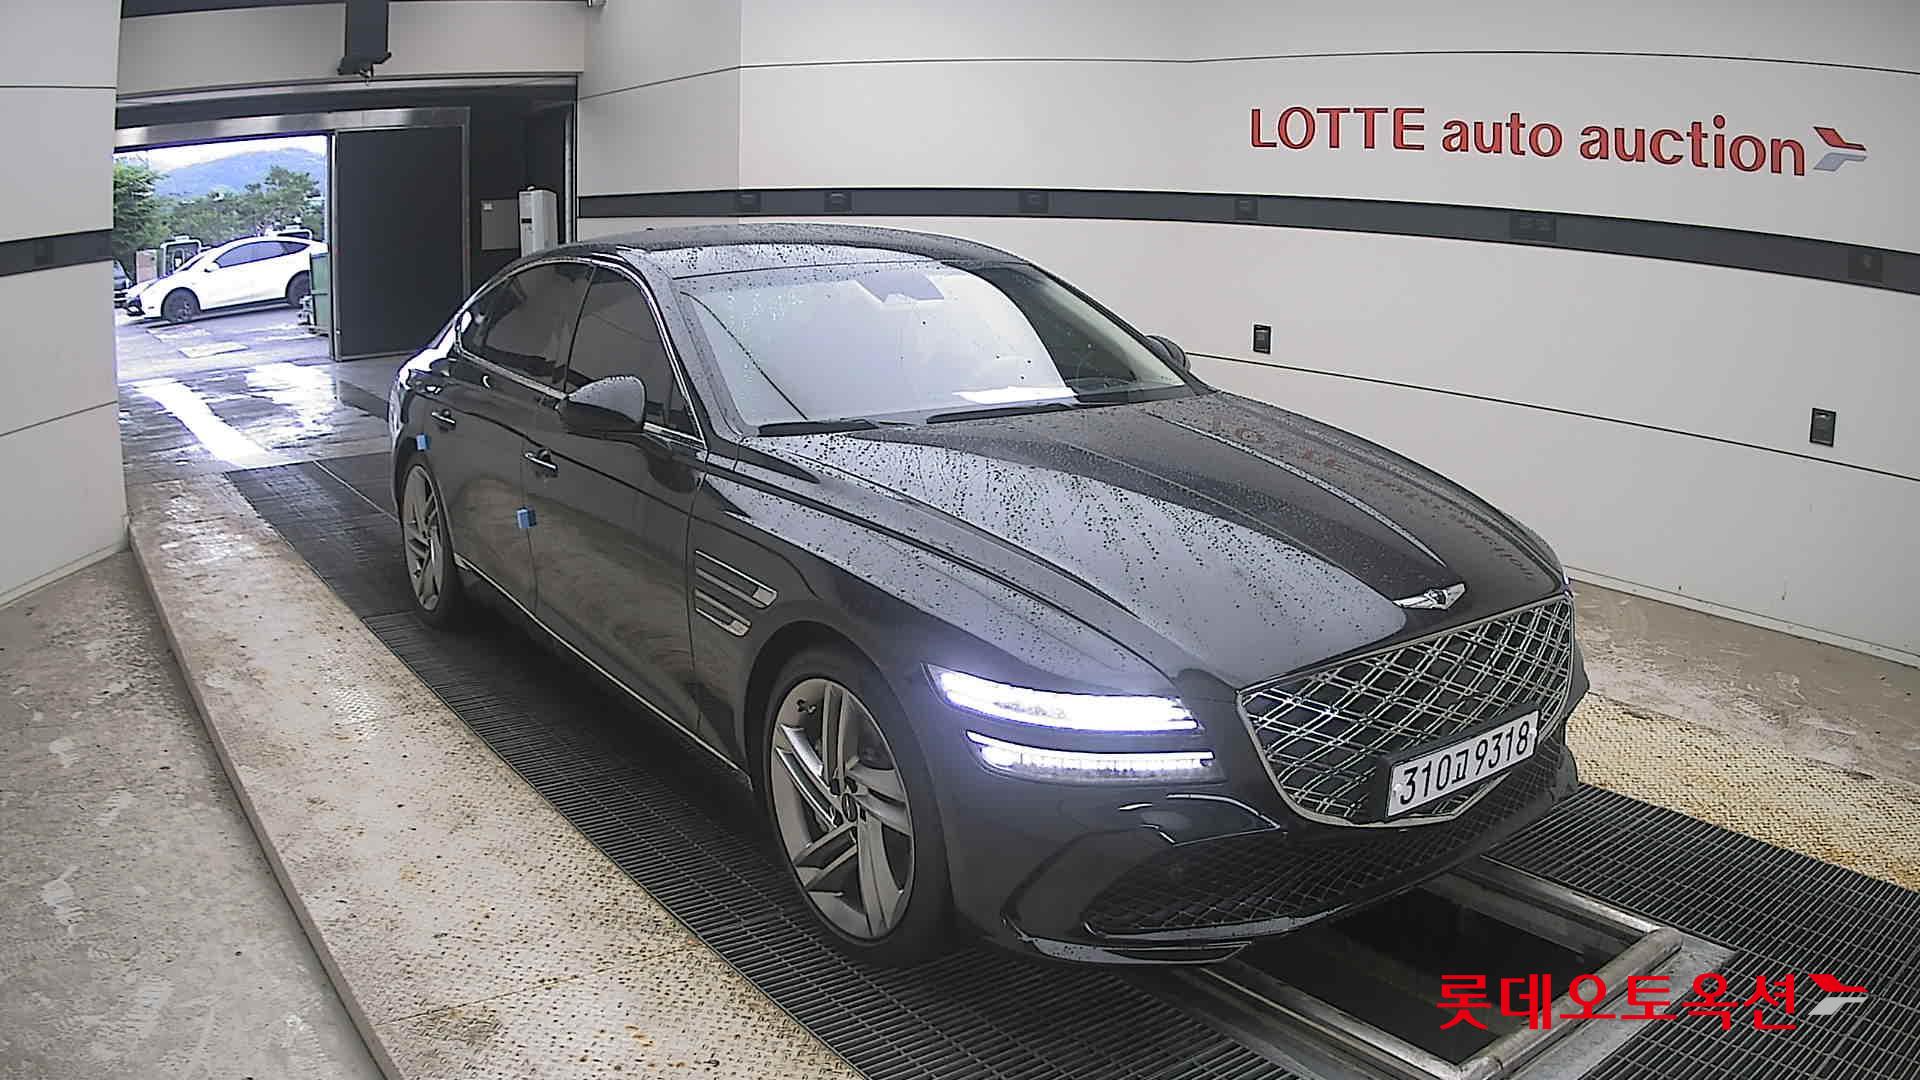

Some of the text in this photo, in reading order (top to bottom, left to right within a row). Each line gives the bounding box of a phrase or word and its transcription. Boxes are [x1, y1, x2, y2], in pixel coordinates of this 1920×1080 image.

[1250, 106, 1806, 177] LOTTE auto auction
[1399, 720, 1530, 805] 310고9318
